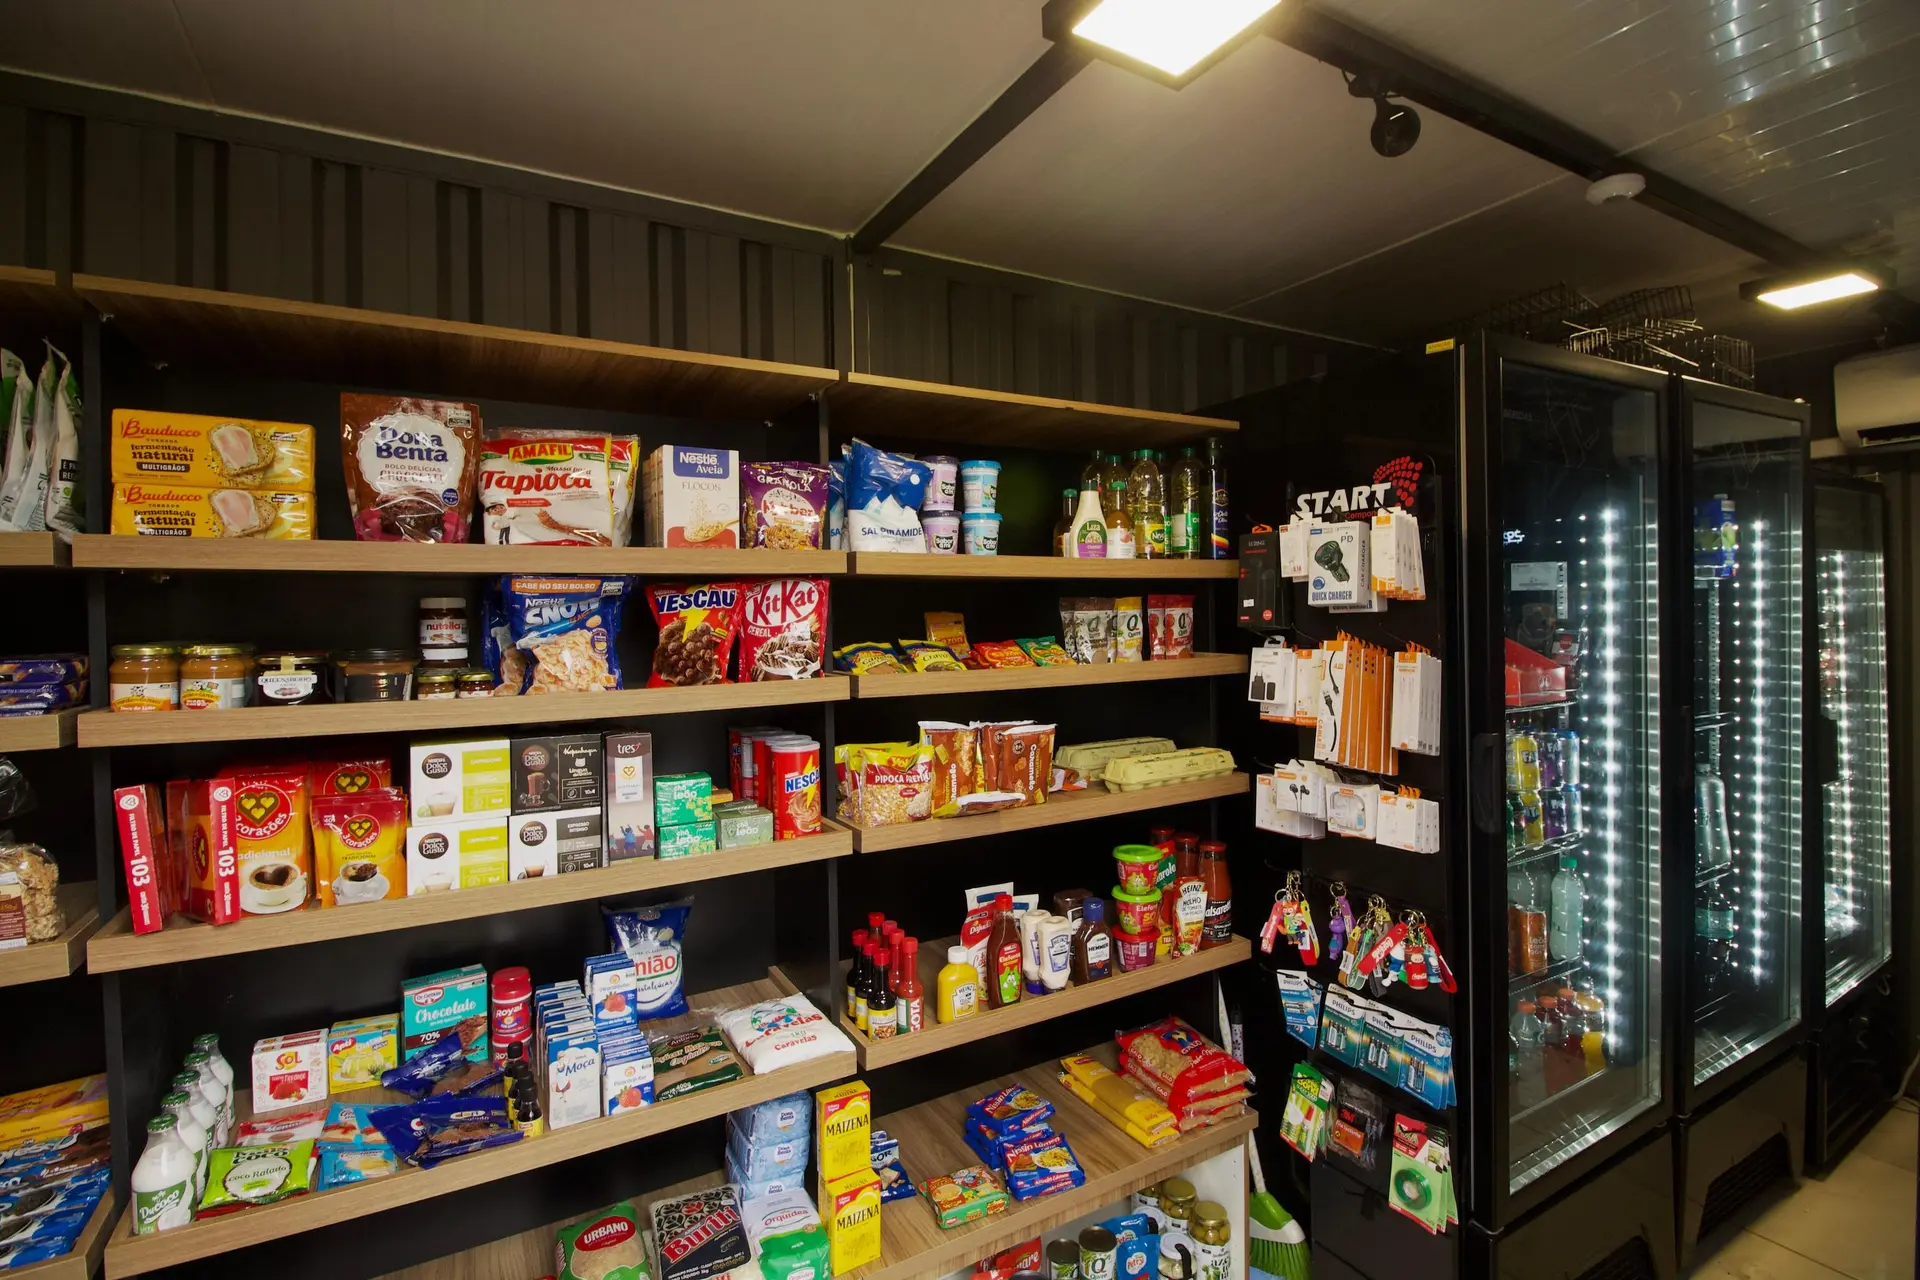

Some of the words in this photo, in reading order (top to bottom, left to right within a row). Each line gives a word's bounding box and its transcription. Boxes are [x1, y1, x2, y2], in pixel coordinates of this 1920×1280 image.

[121, 418, 202, 438] Bauducco
[377, 426, 443, 447] Dona
[130, 444, 194, 453] fermentação
[132, 450, 195, 462] natural
[375, 445, 449, 463] Benta
[511, 444, 573, 462] AMAFIL
[679, 451, 720, 466] Nestlé
[142, 463, 186, 472] MULTIGRÃOS
[410, 465, 442, 473] DELÍCIAS
[696, 465, 723, 475] Aveia
[480, 468, 592, 496] Tapioca
[682, 481, 722, 492] FLOCOS
[757, 474, 812, 493] GRANOLA
[123, 484, 203, 504] Bauducco
[1296, 481, 1392, 516] START
[133, 509, 196, 518] fermentação
[861, 527, 878, 536] SAL
[1340, 535, 1354, 544] PD
[515, 581, 537, 590] CABE
[539, 582, 550, 590] NO
[552, 582, 568, 590] SEU
[569, 582, 596, 590] BOLSO
[750, 580, 816, 625] KitKat
[1312, 591, 1327, 602] QUICK
[1328, 590, 1353, 601] CHARGER
[524, 597, 601, 629] SNOW
[426, 621, 461, 631] nutella
[748, 626, 772, 638] CEREAL
[616, 743, 635, 754] tres
[784, 767, 820, 793] NESCA
[875, 775, 904, 784] PIPOCA
[218, 847, 235, 877] 103
[131, 856, 151, 887] 103
[1181, 883, 1202, 895] HEINZ
[1136, 904, 1158, 912] Elefan
[1182, 897, 1202, 906] MOLHO
[1088, 942, 1109, 952] HEMMER
[635, 954, 676, 977] nião
[1283, 978, 1304, 987] PHILIPS
[415, 998, 477, 1024] Chocolate
[1331, 999, 1356, 1016] PHILIPS
[333, 1038, 352, 1052] Apti
[420, 1031, 441, 1042] 70%
[773, 1033, 818, 1051] Caravelas
[1410, 1034, 1437, 1054] PHILIPS
[653, 1048, 683, 1064] Açúcar
[1180, 1040, 1203, 1055] GALO
[565, 1058, 596, 1077] Moça
[825, 1113, 869, 1138] MAIZENA
[1006, 1144, 1033, 1163] Nissin
[228, 1173, 251, 1182] coco
[252, 1165, 287, 1178] Ralado
[139, 1189, 180, 1219] Ducoco
[764, 1208, 810, 1227] Orquídea
[836, 1203, 880, 1232] MAIZENA
[583, 1221, 629, 1245] URBANO
[661, 1205, 740, 1264] Buriti
